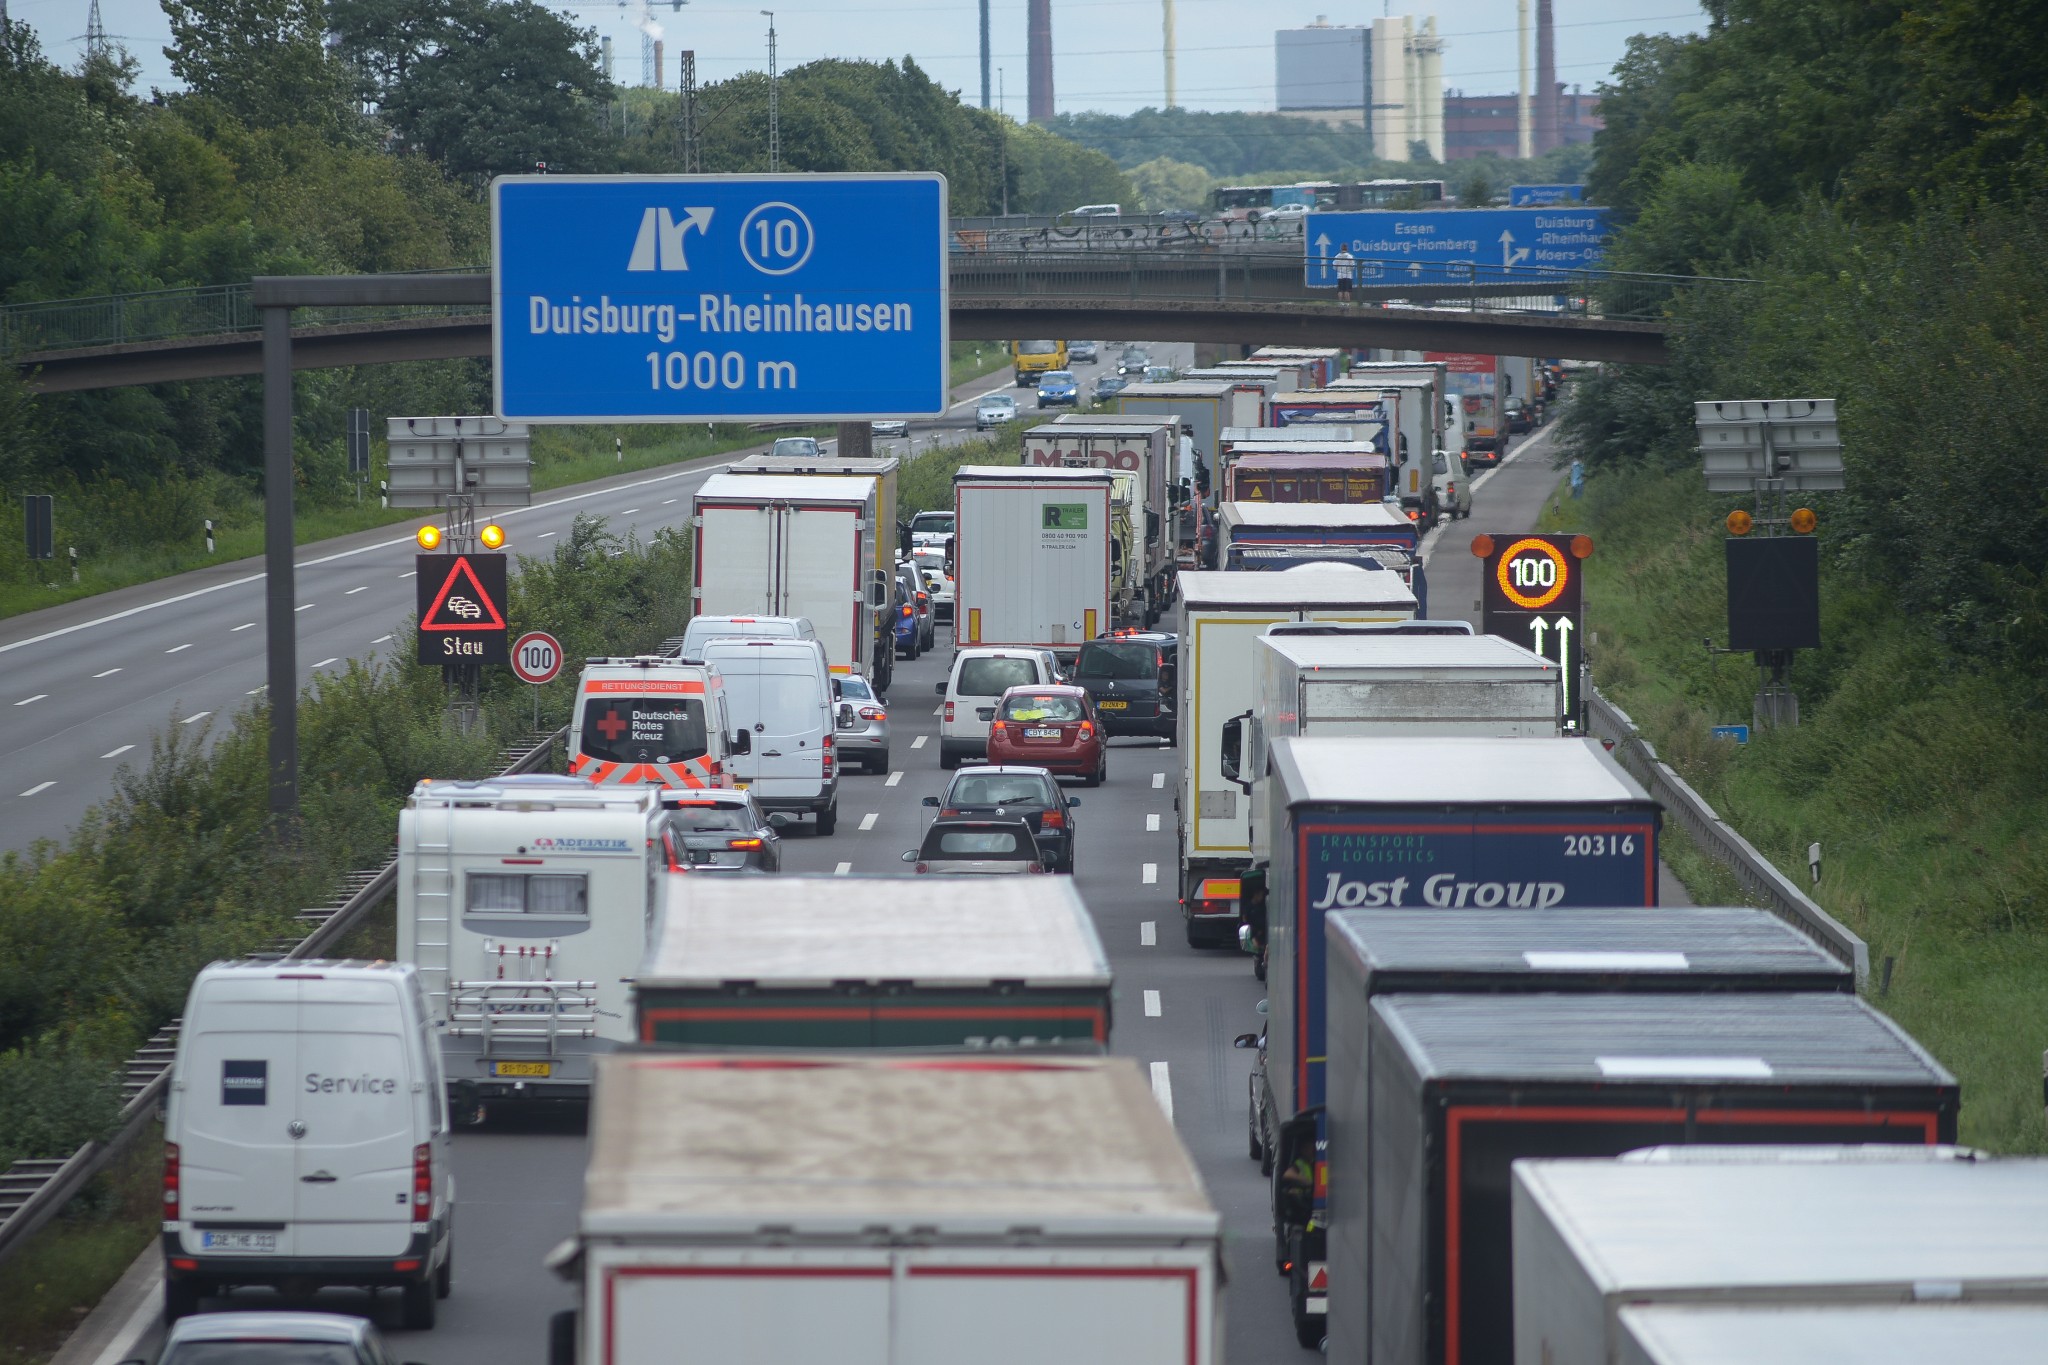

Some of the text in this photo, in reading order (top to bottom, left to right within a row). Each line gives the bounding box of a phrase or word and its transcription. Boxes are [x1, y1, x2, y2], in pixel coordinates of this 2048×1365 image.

[1395, 222, 1436, 235] Essen
[1535, 216, 1594, 230] Duisburg
[755, 218, 798, 258] 10
[1352, 239, 1478, 254] Duisburg-Homberg
[1536, 232, 1602, 245] -Rheinhau
[529, 294, 912, 343] Duisburg-Rheinhausen
[646, 350, 797, 390] 1000 m
[1045, 506, 1062, 527] R
[1509, 558, 1557, 587] 100
[443, 637, 484, 656] Stau
[522, 646, 552, 669] 100
[601, 682, 685, 691] RETTUNGSDIENST
[632, 711, 688, 721] Deutsches
[632, 721, 664, 731] Rotes
[632, 731, 663, 741] Kreuz
[1321, 835, 1425, 848] TRANSPORT
[1564, 834, 1635, 856] 20316
[1320, 850, 1435, 863] & LOGISTICS
[1312, 872, 1565, 911] Jost Group
[304, 1073, 396, 1095] Service
